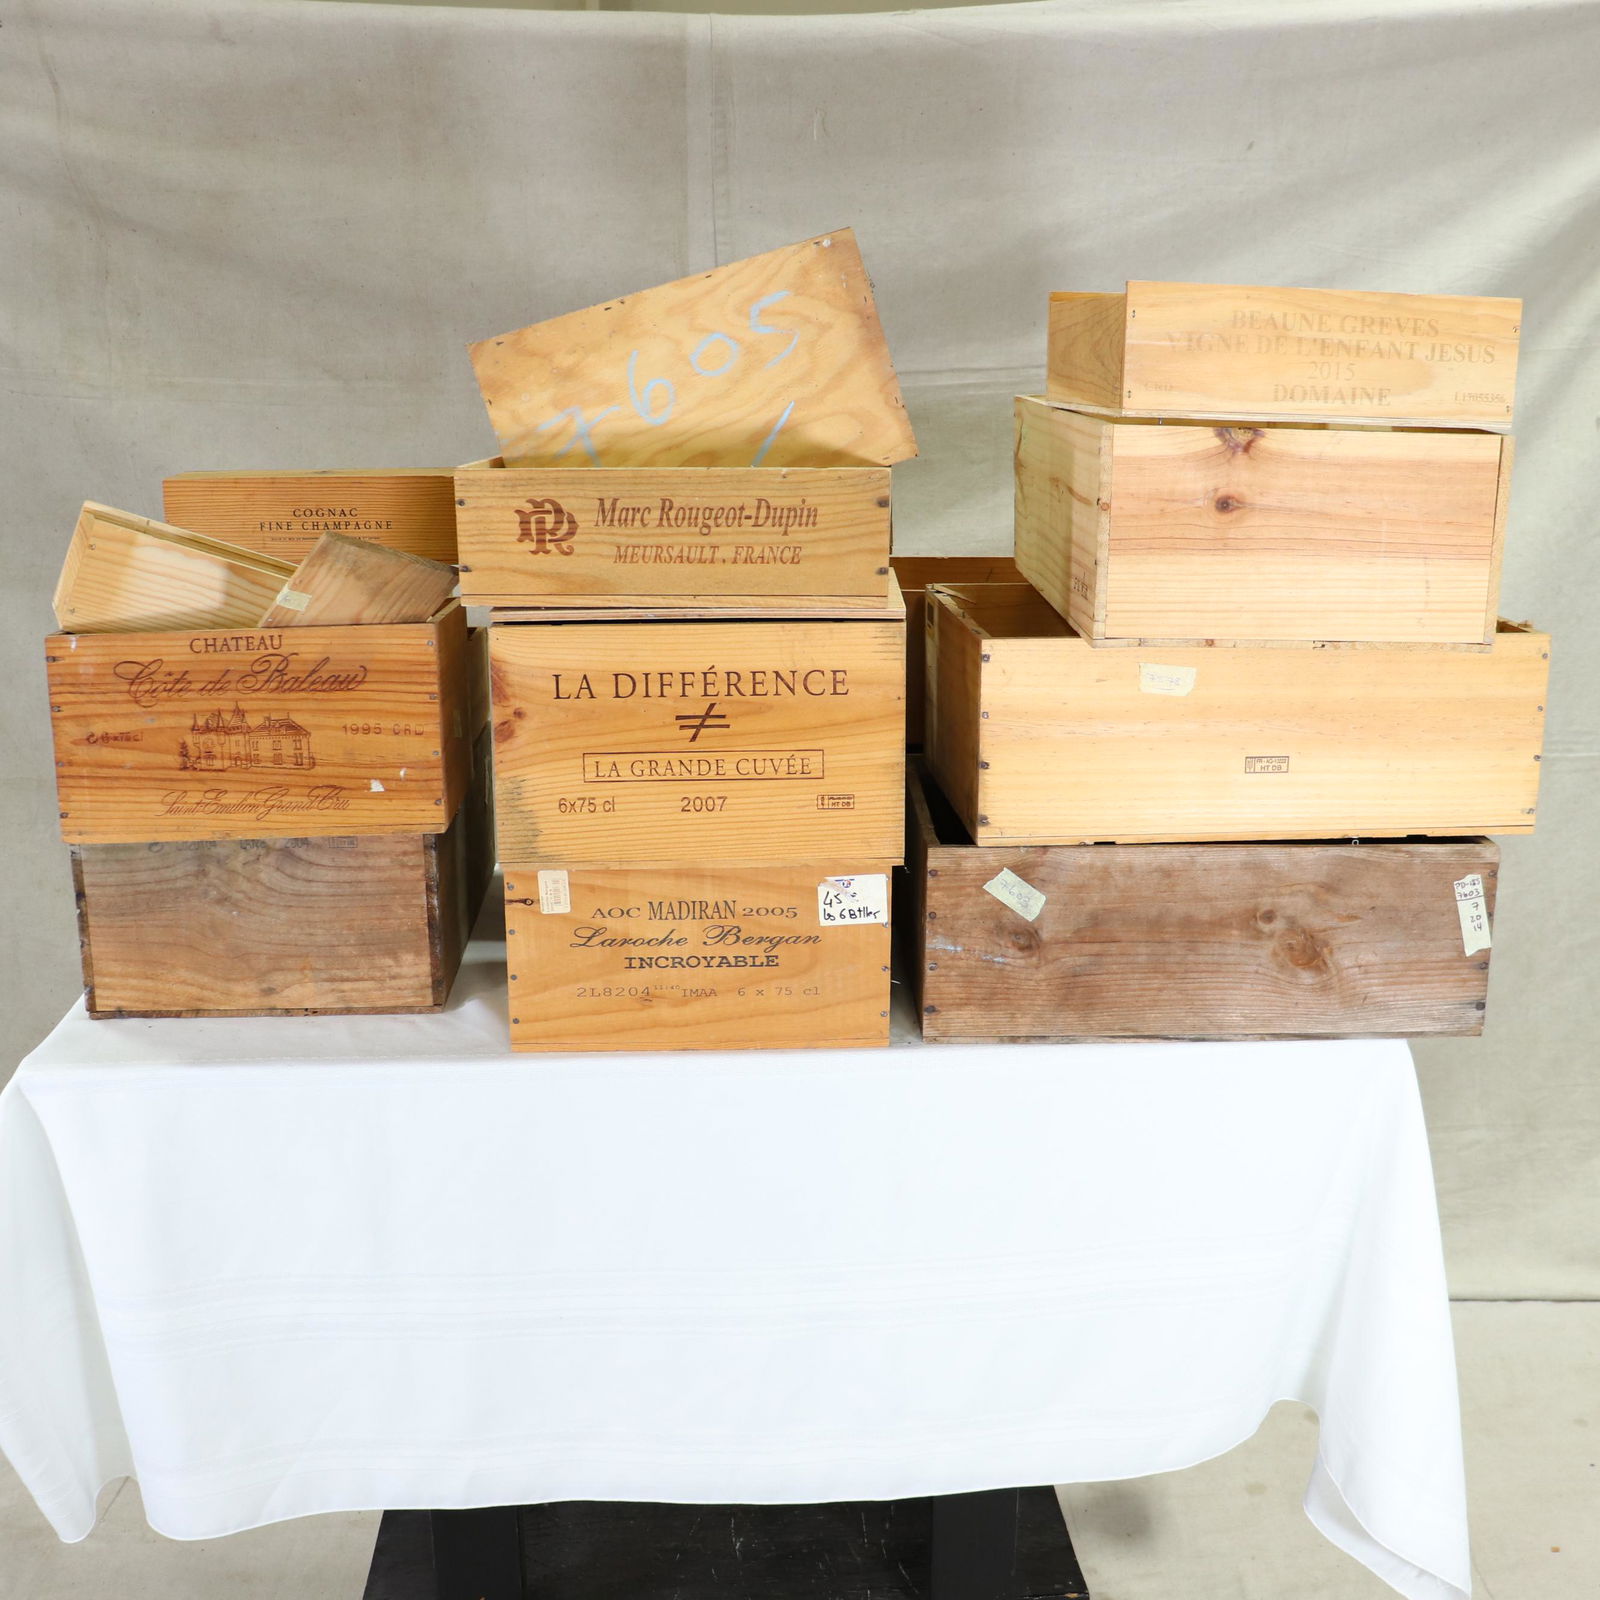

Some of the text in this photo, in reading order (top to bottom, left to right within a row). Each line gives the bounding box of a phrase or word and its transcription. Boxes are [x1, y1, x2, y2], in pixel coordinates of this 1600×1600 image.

[1232, 310, 1440, 338] BEAUNE GREVES
[1257, 335, 1289, 354] DE
[1425, 343, 1496, 365] JESUS
[1307, 361, 1355, 381] 2015
[1273, 384, 1392, 407] DOMAINE
[292, 507, 359, 518] COGNAC
[593, 497, 819, 536] Marc Rougeot-Dupin
[260, 520, 393, 531] FINE CHAMPAGNE
[731, 545, 803, 565] FRANCE
[189, 634, 284, 654] CHATEAU
[200, 669, 234, 697] de
[236, 653, 368, 695] Baleau
[552, 664, 850, 700] LA DIFFÉRENCE
[341, 722, 383, 736] 1995
[594, 754, 813, 778] LA GRANDE CUVÉE
[558, 797, 598, 814] 6x75
[680, 796, 729, 813] 2007
[592, 900, 799, 921] AOC MADIRAN 2005
[569, 924, 822, 953] Laroche Bergan
[624, 954, 780, 970] INCROYABLE
[577, 986, 651, 998] 2L8204
[681, 987, 718, 998] IMAA
